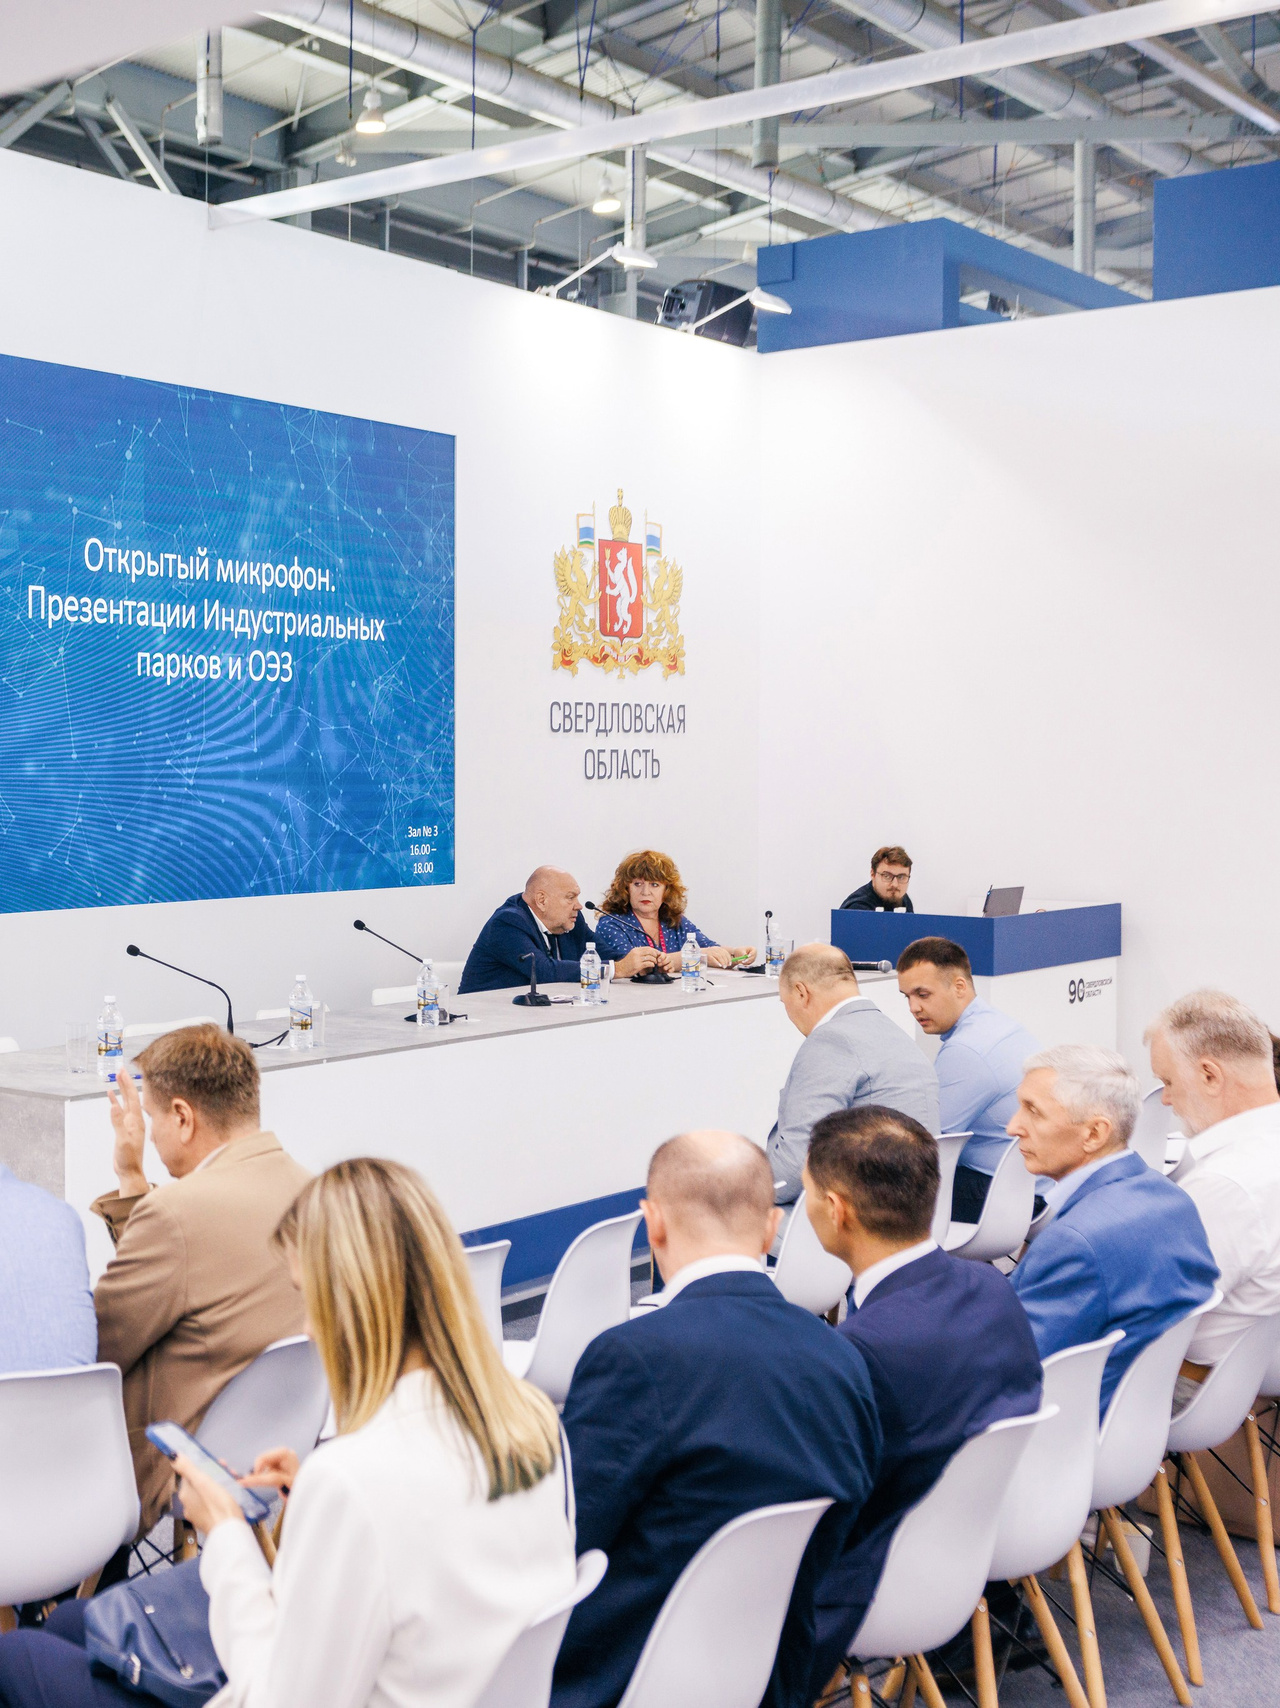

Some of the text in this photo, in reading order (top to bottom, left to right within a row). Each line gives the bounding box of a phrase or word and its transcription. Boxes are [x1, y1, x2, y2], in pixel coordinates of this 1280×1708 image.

[84, 537, 336, 597] Открытый микрофон.
[27, 584, 386, 643] Презентации Индустриальных
[137, 649, 293, 686] парков и ОЭЗ
[549, 701, 686, 738] СВЕРДЛОВСКАЯ
[584, 748, 661, 780] ОБЛАСТЬ
[407, 826, 422, 838] Зал
[422, 825, 432, 837] №
[410, 844, 431, 856] 16.00
[413, 862, 434, 874] 18.00
[1068, 978, 1085, 1004] 90
